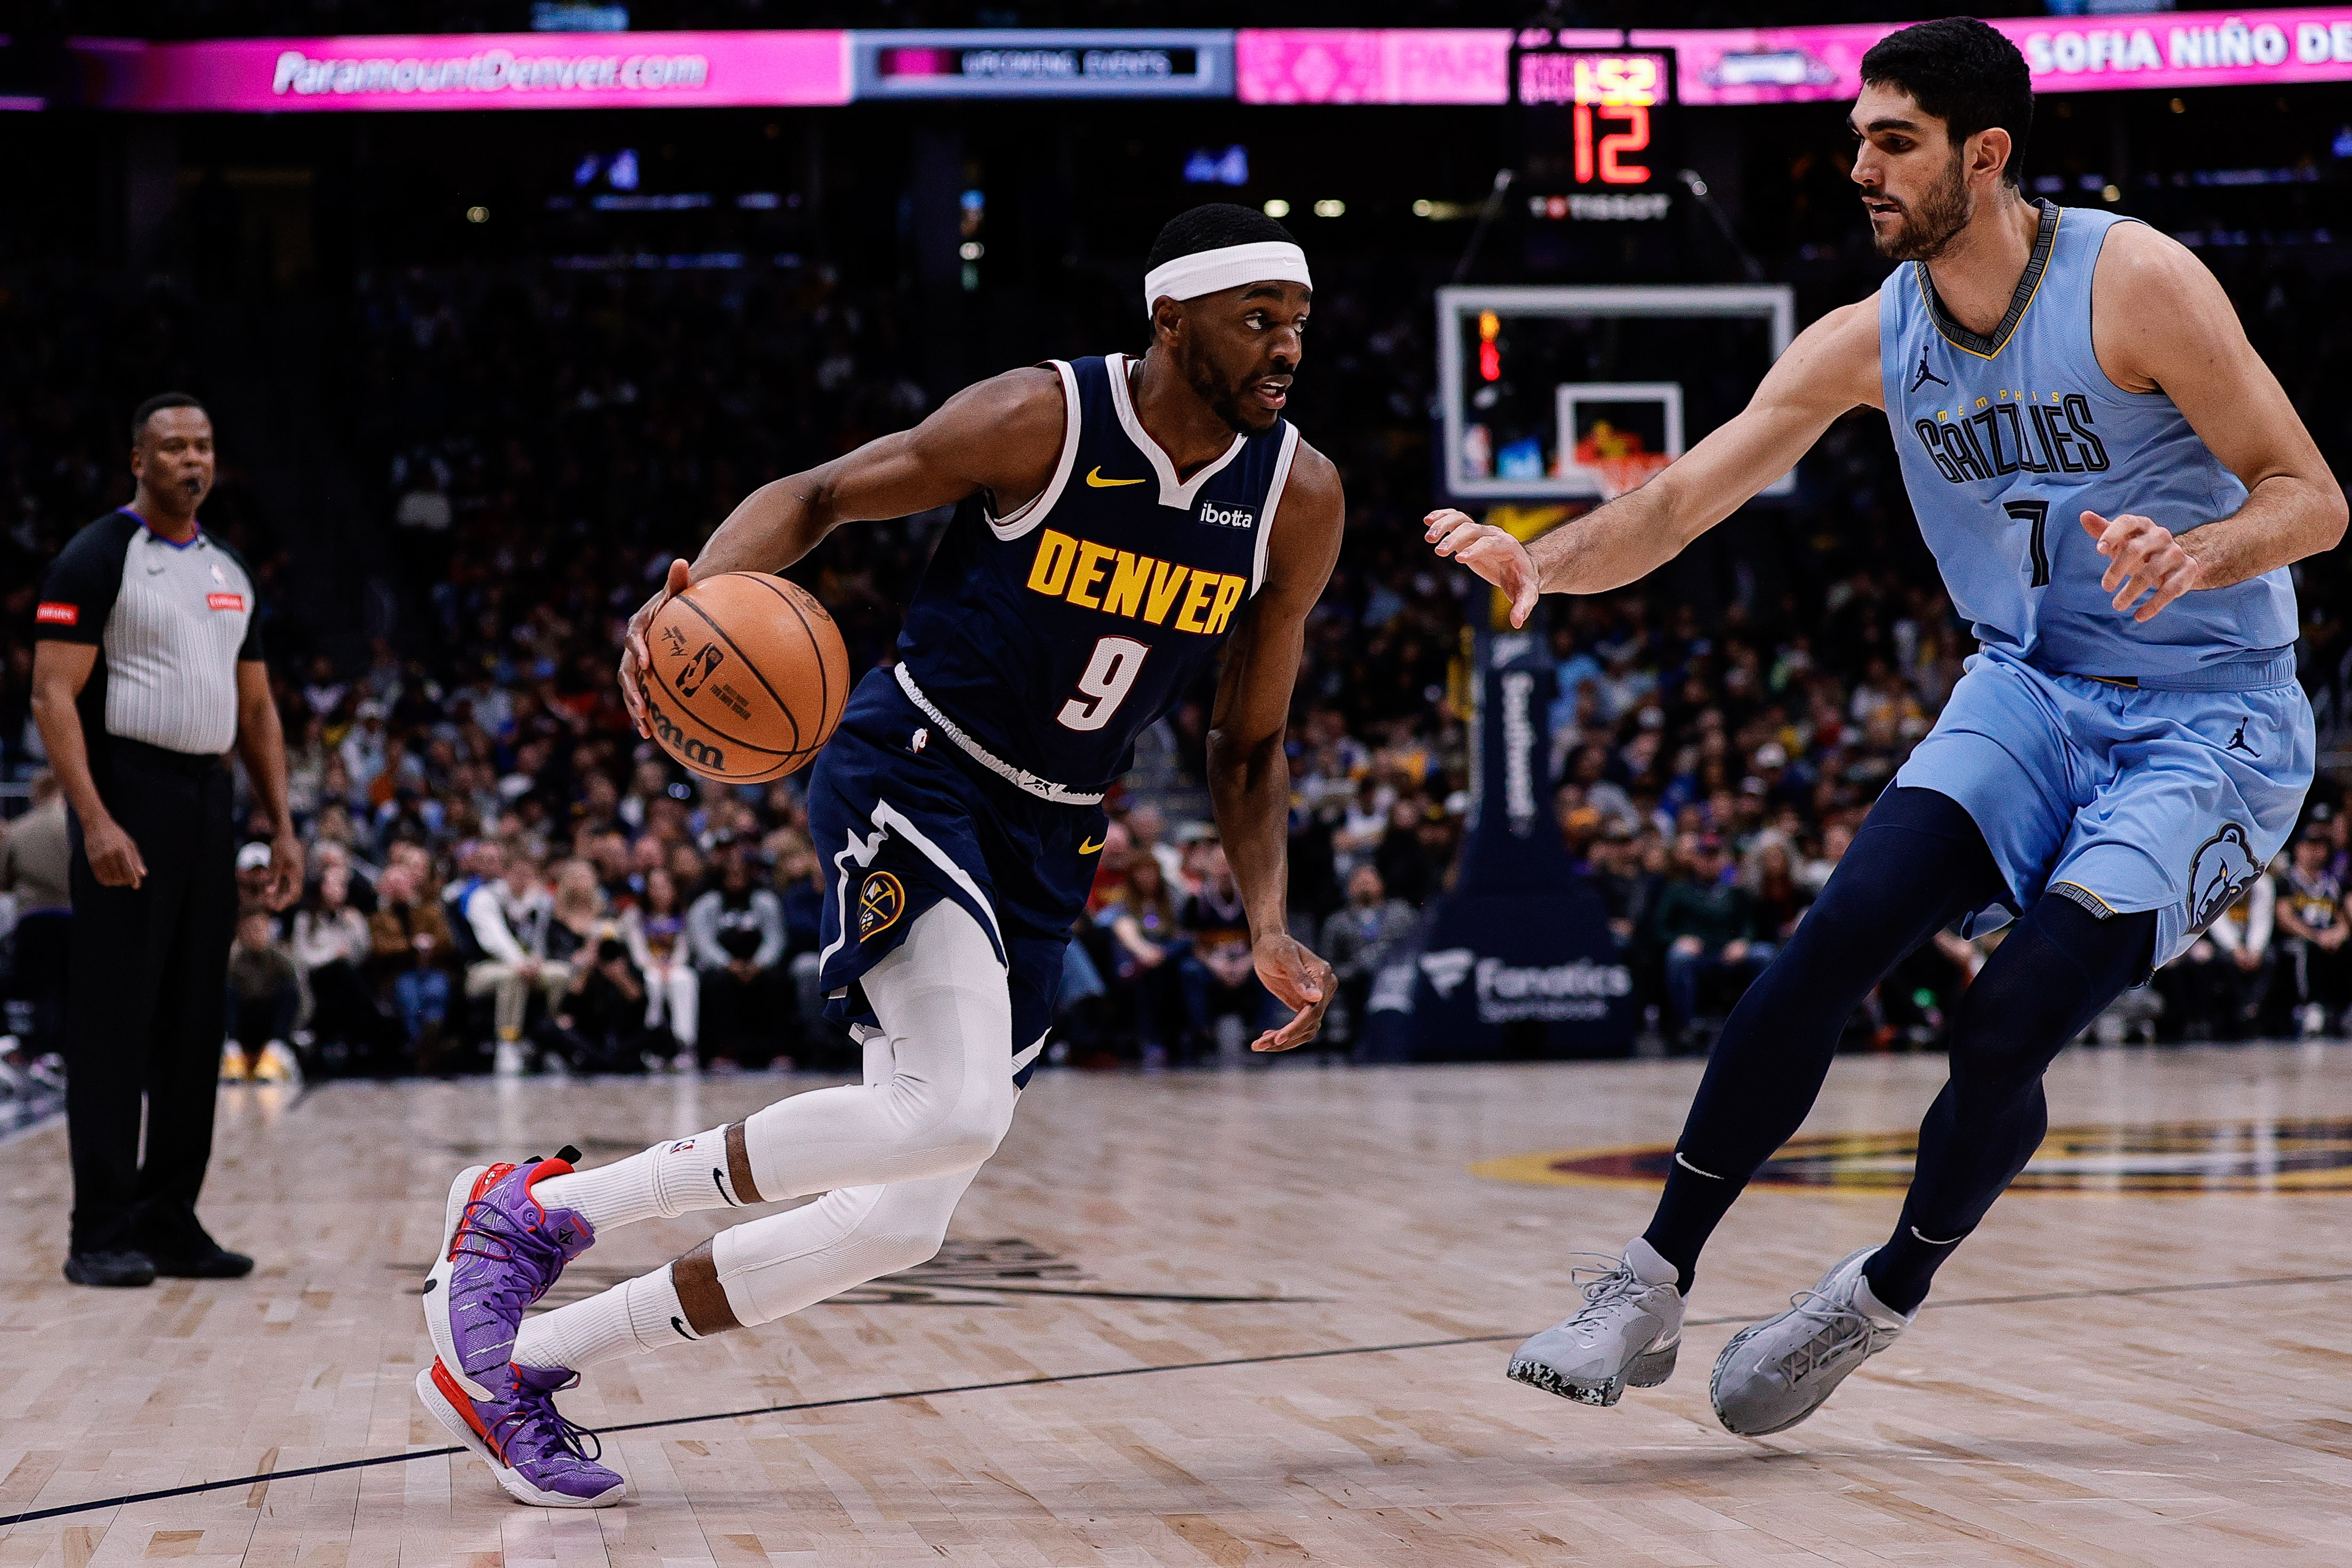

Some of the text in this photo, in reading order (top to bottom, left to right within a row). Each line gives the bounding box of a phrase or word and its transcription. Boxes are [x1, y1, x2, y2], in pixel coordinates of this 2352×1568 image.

[273, 49, 709, 95] ParamountDenver.com
[2027, 28, 2164, 75] SOFIA
[2169, 17, 2290, 69] NIÑO
[1574, 106, 1651, 183] 12
[1915, 393, 2110, 483] GRIZZLIES
[1200, 503, 1252, 528] ibotta
[2002, 500, 2050, 588] 7
[1025, 527, 1247, 635] DENVER
[1055, 634, 1152, 733] 9
[1476, 958, 1632, 998] Fanatics
